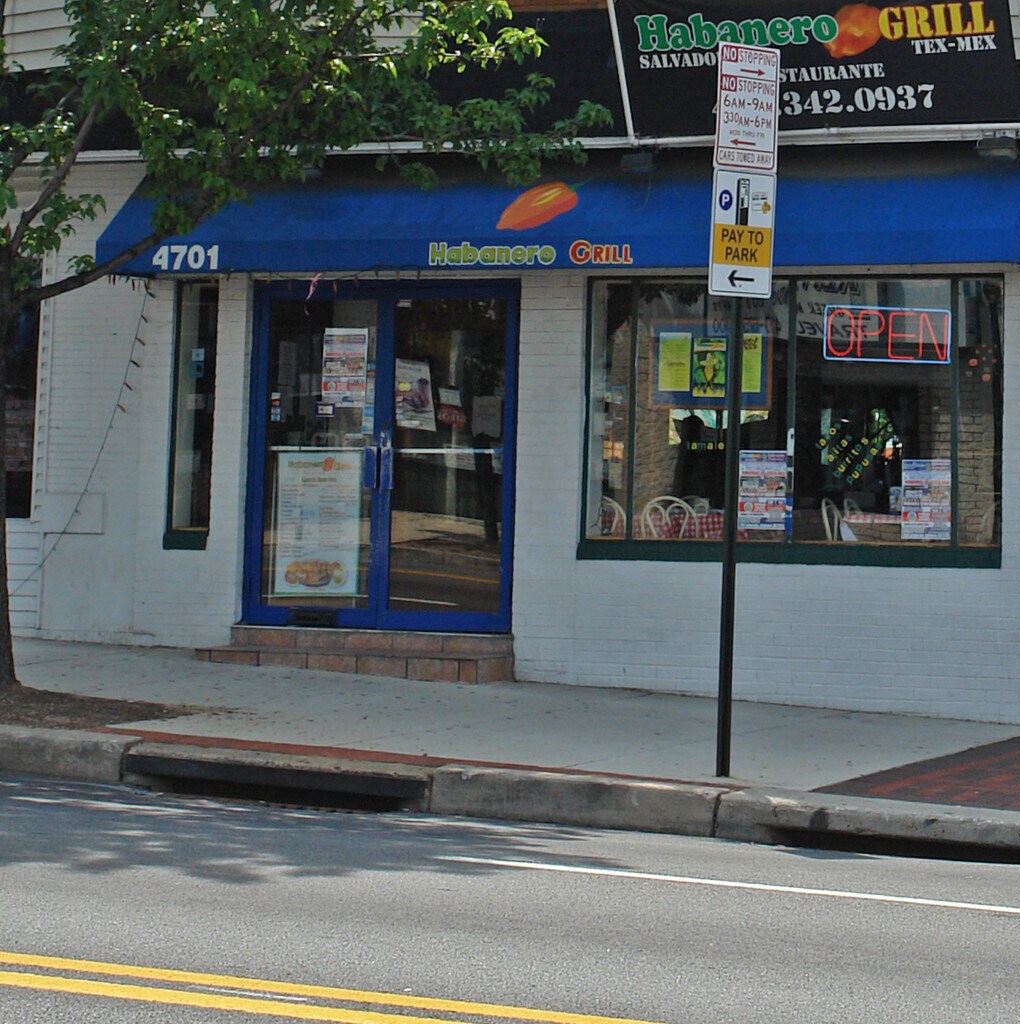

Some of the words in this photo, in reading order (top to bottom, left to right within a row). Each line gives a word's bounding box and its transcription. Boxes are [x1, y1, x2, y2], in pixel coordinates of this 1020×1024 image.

[634, 13, 838, 52] Habanero
[878, 0, 996, 41] GRILL
[911, 35, 997, 55] TEX-MEX
[639, 51, 718, 69] SALVADO
[779, 63, 886, 83] STAURANTE
[723, 47, 737, 61] NO
[739, 50, 777, 67] STOPPING
[722, 76, 736, 90] NO
[738, 79, 775, 96] STOPPING
[723, 94, 773, 113] 6AM-9AM
[718, 149, 736, 161] CARS
[736, 151, 755, 163] TOWED
[756, 153, 772, 166] AWAY
[721, 228, 744, 244] PAY
[747, 230, 764, 246] TO
[152, 244, 220, 271] 4701
[429, 241, 556, 266] Habanero
[725, 246, 758, 263] PARK
[826, 308, 949, 361] OPEN
